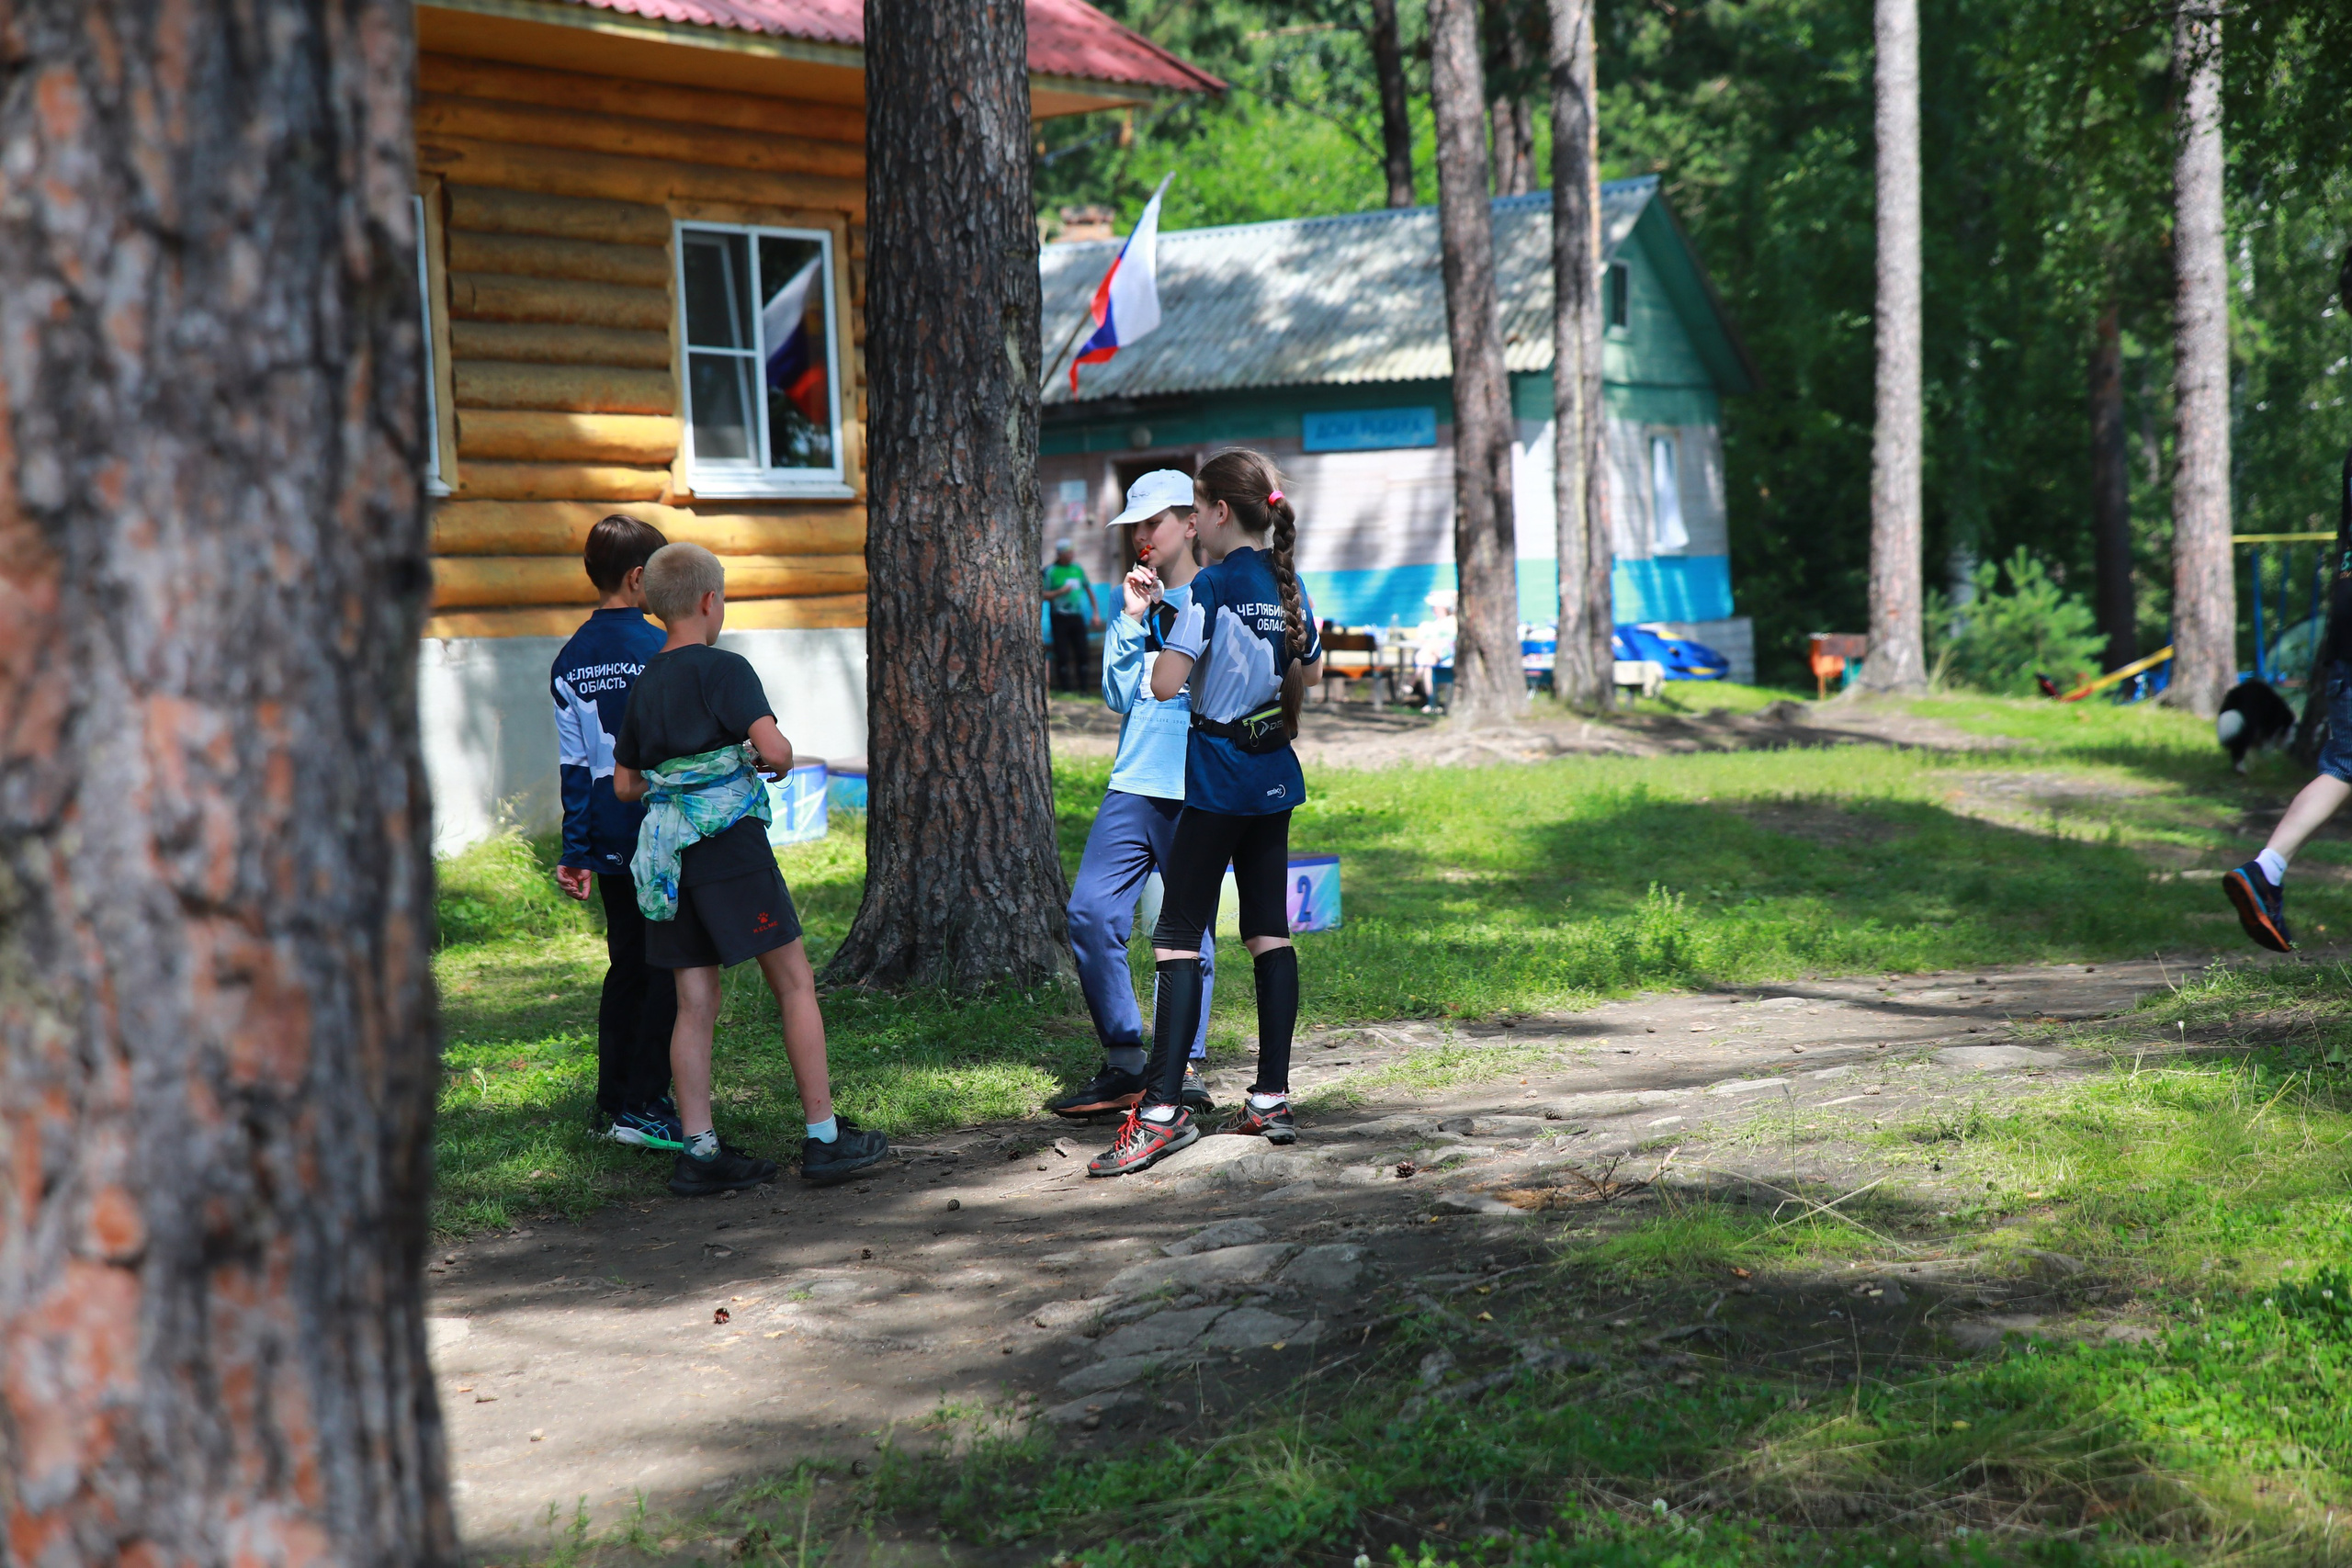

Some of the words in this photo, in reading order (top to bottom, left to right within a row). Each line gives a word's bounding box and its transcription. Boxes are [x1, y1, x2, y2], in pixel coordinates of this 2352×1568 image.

[1236, 603, 1306, 621] ЧЕЛЯБИНЯ
[1257, 617, 1286, 632] ОБЛАС
[781, 784, 795, 831] 1
[1296, 874, 1313, 923] 2
[753, 920, 778, 934] KELME
